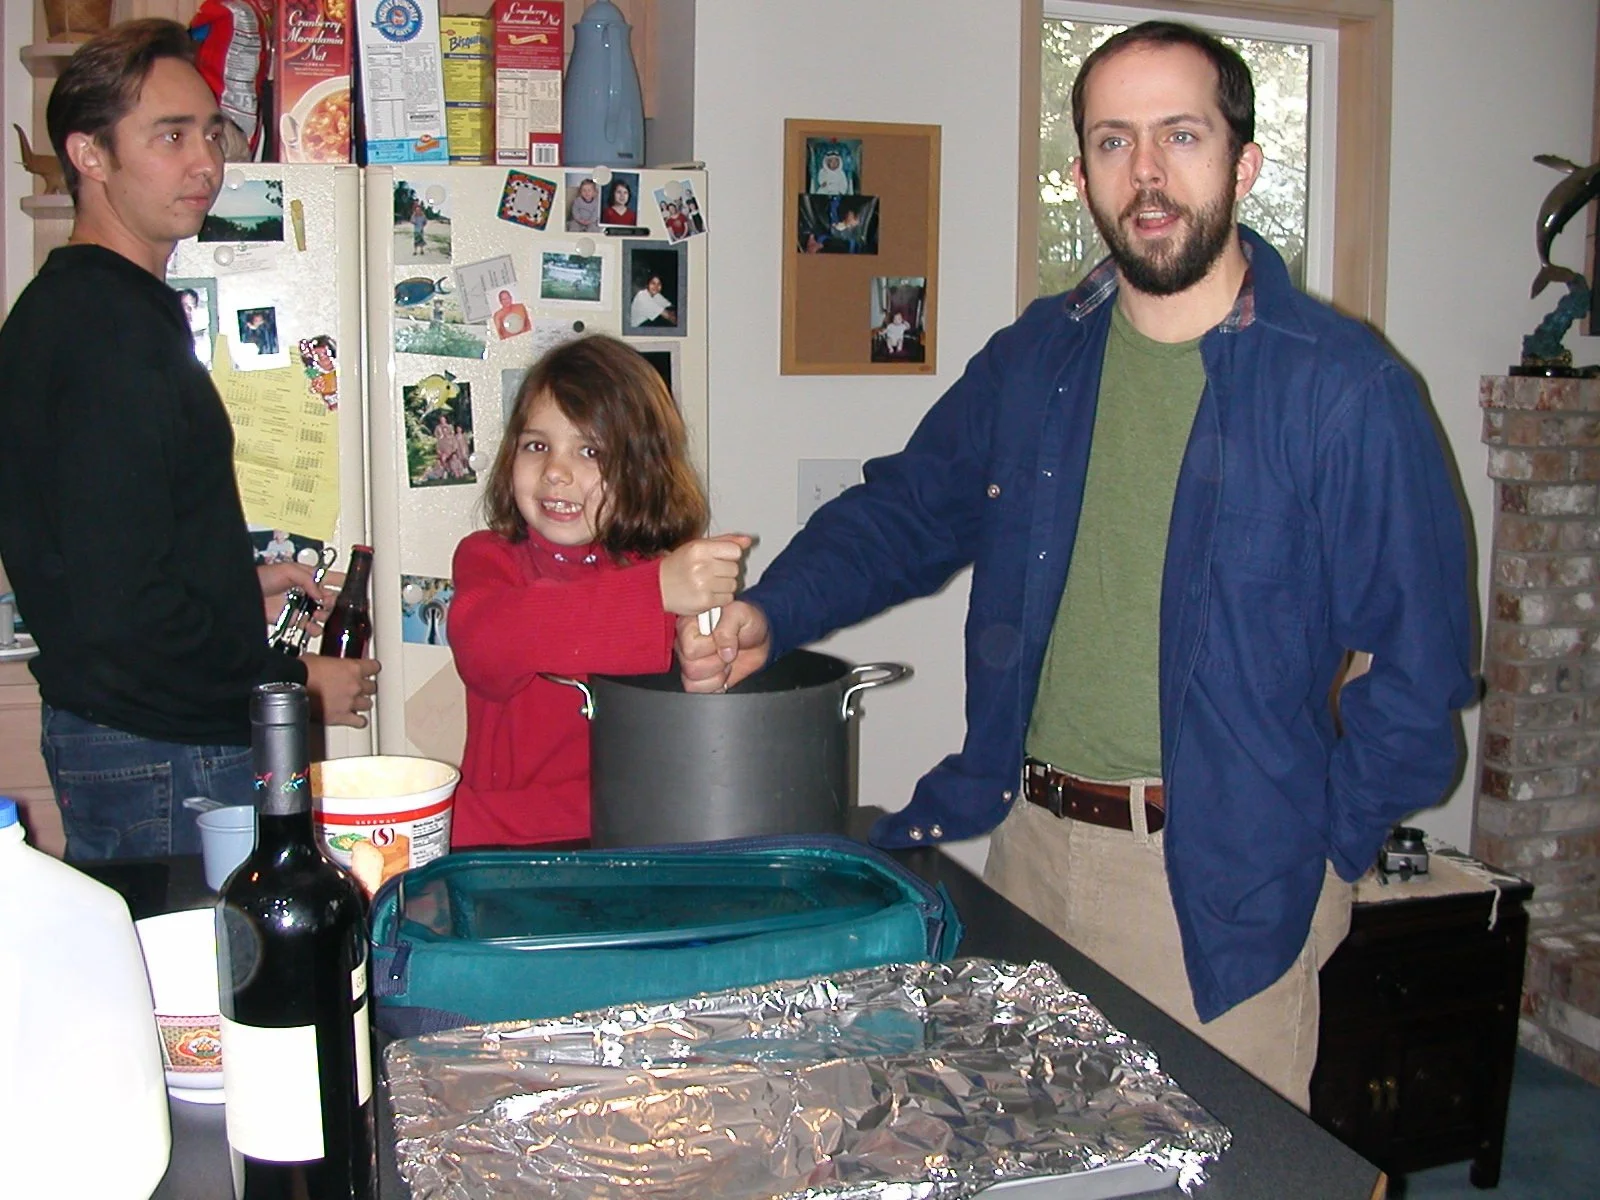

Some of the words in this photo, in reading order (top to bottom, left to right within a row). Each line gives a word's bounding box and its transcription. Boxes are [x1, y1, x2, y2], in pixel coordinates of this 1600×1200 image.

[501, 12, 541, 25] Macadamia
[543, 14, 561, 26] Nut
[509, 2, 548, 19] Cranberry
[288, 10, 342, 33] Cranberry
[282, 27, 344, 45] Macadamia
[301, 45, 328, 61] Nut
